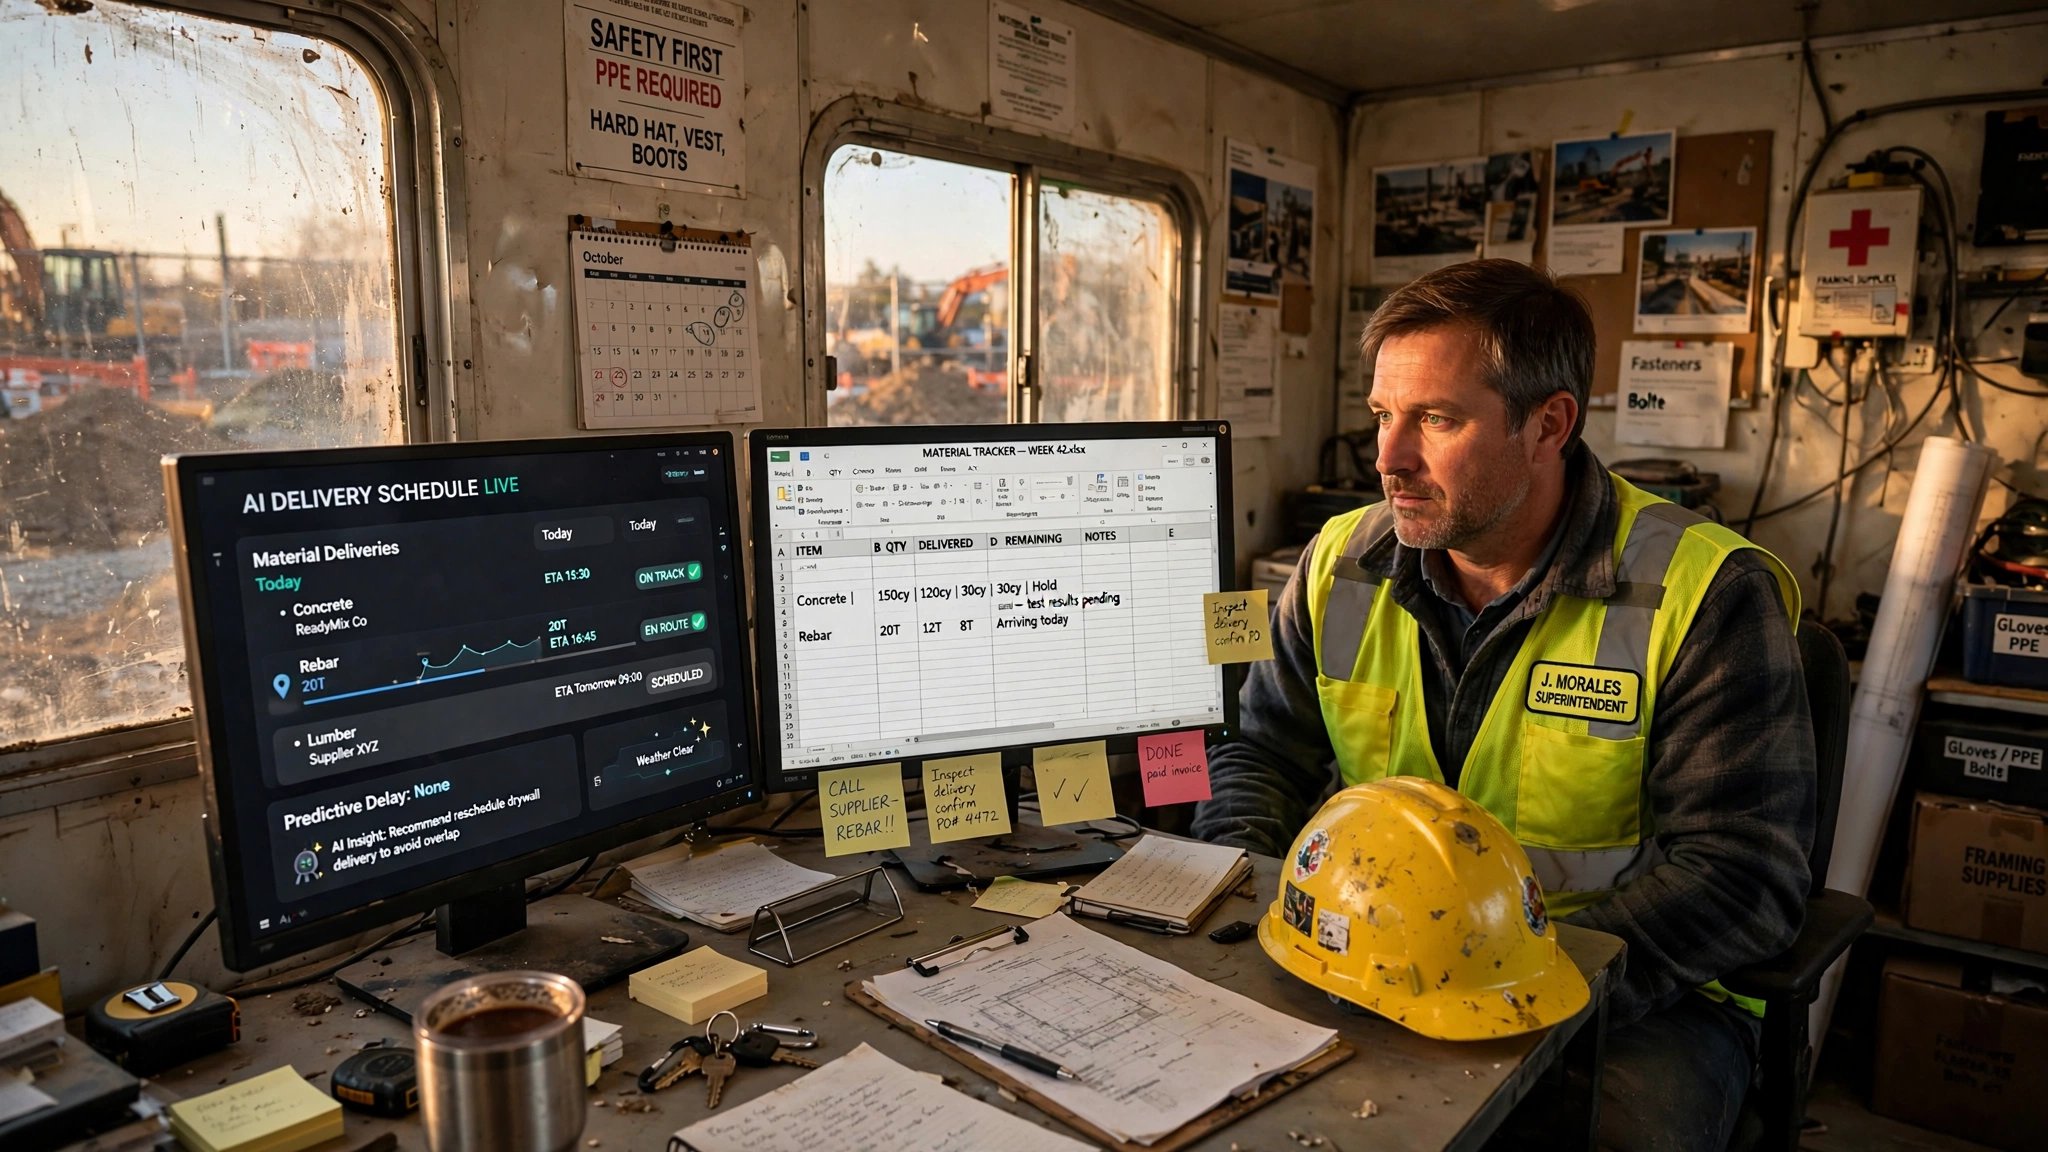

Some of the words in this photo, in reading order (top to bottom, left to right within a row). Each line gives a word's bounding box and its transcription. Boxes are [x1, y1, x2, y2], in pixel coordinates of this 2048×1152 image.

[590, 18, 667, 62] SAFETY
[672, 38, 723, 76] FIRST
[595, 58, 631, 91] PPE
[636, 67, 722, 109] REQUIRED
[590, 108, 639, 137] HARD
[643, 118, 679, 148] HAT,
[683, 126, 725, 156] VEST,
[632, 142, 688, 172] BOOTS
[582, 250, 624, 265] October
[1631, 355, 1702, 372] Fasteners
[634, 393, 644, 401] 30
[922, 446, 972, 459] MATERIAL
[973, 446, 1017, 458] TRACKER
[1027, 445, 1054, 456] WEEK
[242, 492, 266, 514] AI
[270, 485, 372, 512] DELIVERY
[377, 479, 479, 503] SCHEDULE
[484, 476, 520, 495] LIVE
[541, 528, 573, 541] Today
[629, 518, 657, 532] Today
[777, 547, 786, 557] A
[796, 545, 823, 557] ITEM
[873, 542, 881, 553] B
[885, 540, 907, 554] QTY
[918, 538, 974, 551] DELIVERED
[989, 537, 998, 547] D
[1005, 533, 1063, 546] REMAINING
[1084, 530, 1117, 542] NOTES
[1168, 528, 1175, 538] E
[252, 546, 321, 569] Material
[324, 540, 400, 562] Deliveries
[255, 574, 302, 592] Today
[544, 571, 564, 584] ETA
[565, 567, 591, 581] 15:30
[638, 573, 654, 584] ON
[655, 568, 686, 581] TRACK
[796, 593, 847, 607] Concrete
[878, 589, 910, 604] 150cy
[920, 586, 952, 600] 120cy
[961, 584, 986, 598] 30cy
[996, 582, 1022, 595] 30cy
[1032, 579, 1057, 592] Hold
[1027, 597, 1046, 609] test
[1049, 593, 1079, 608] results
[1082, 591, 1120, 609] pending
[292, 598, 354, 617] Concrete
[295, 617, 351, 636] ReadyMix
[352, 615, 368, 628] Co
[548, 619, 568, 632] 20T
[644, 625, 659, 636] EN
[660, 618, 689, 633] ROUTE
[798, 629, 832, 643] Rebar
[879, 624, 901, 637] 20T
[922, 622, 943, 634] 12T
[959, 619, 974, 632] 8T
[996, 616, 1038, 630] Arriving
[1039, 614, 1069, 628] today
[550, 636, 570, 649] ETA
[571, 630, 598, 645] 16:45
[2008, 636, 2040, 653] PPE
[299, 656, 340, 674] Rebar
[301, 676, 326, 693] 20T
[555, 684, 574, 698] ETA
[573, 677, 617, 694] Tomorrow
[618, 671, 643, 685] 09:00
[651, 668, 704, 689] SCHEDULED
[1541, 672, 1553, 688] J.
[1556, 673, 1622, 697] MORALES
[1534, 690, 1628, 714] SUPERINTENDENT
[307, 728, 357, 748] Lumber
[309, 748, 355, 767] Supplier
[356, 740, 380, 755] XYZ
[635, 750, 672, 767] Weather
[672, 743, 695, 757] Clear
[1145, 742, 1183, 761] DONE
[2011, 749, 2041, 766] PPE
[931, 766, 975, 783] Inspect
[1146, 764, 1167, 784] paid
[1171, 762, 1202, 776] invoice
[828, 778, 866, 798] CALL
[933, 783, 977, 798] delivery
[284, 799, 363, 831] Predictive
[364, 789, 411, 812] Delay:
[413, 779, 451, 799] None
[935, 798, 977, 814] confirm
[331, 839, 345, 853] AI
[346, 829, 388, 850] Insight:
[389, 811, 453, 838] Recommend
[453, 798, 506, 821] reschedule
[507, 788, 541, 809] drywall
[836, 814, 895, 841] REBAR!!
[937, 817, 960, 831] PO#
[965, 810, 1000, 825] 4472
[332, 850, 378, 873] delivery
[379, 848, 392, 860] to
[392, 837, 422, 857] avoid
[423, 828, 460, 849] overlap
[1964, 845, 2047, 876] FRAMING
[1961, 865, 2048, 897] SUPPLIES
